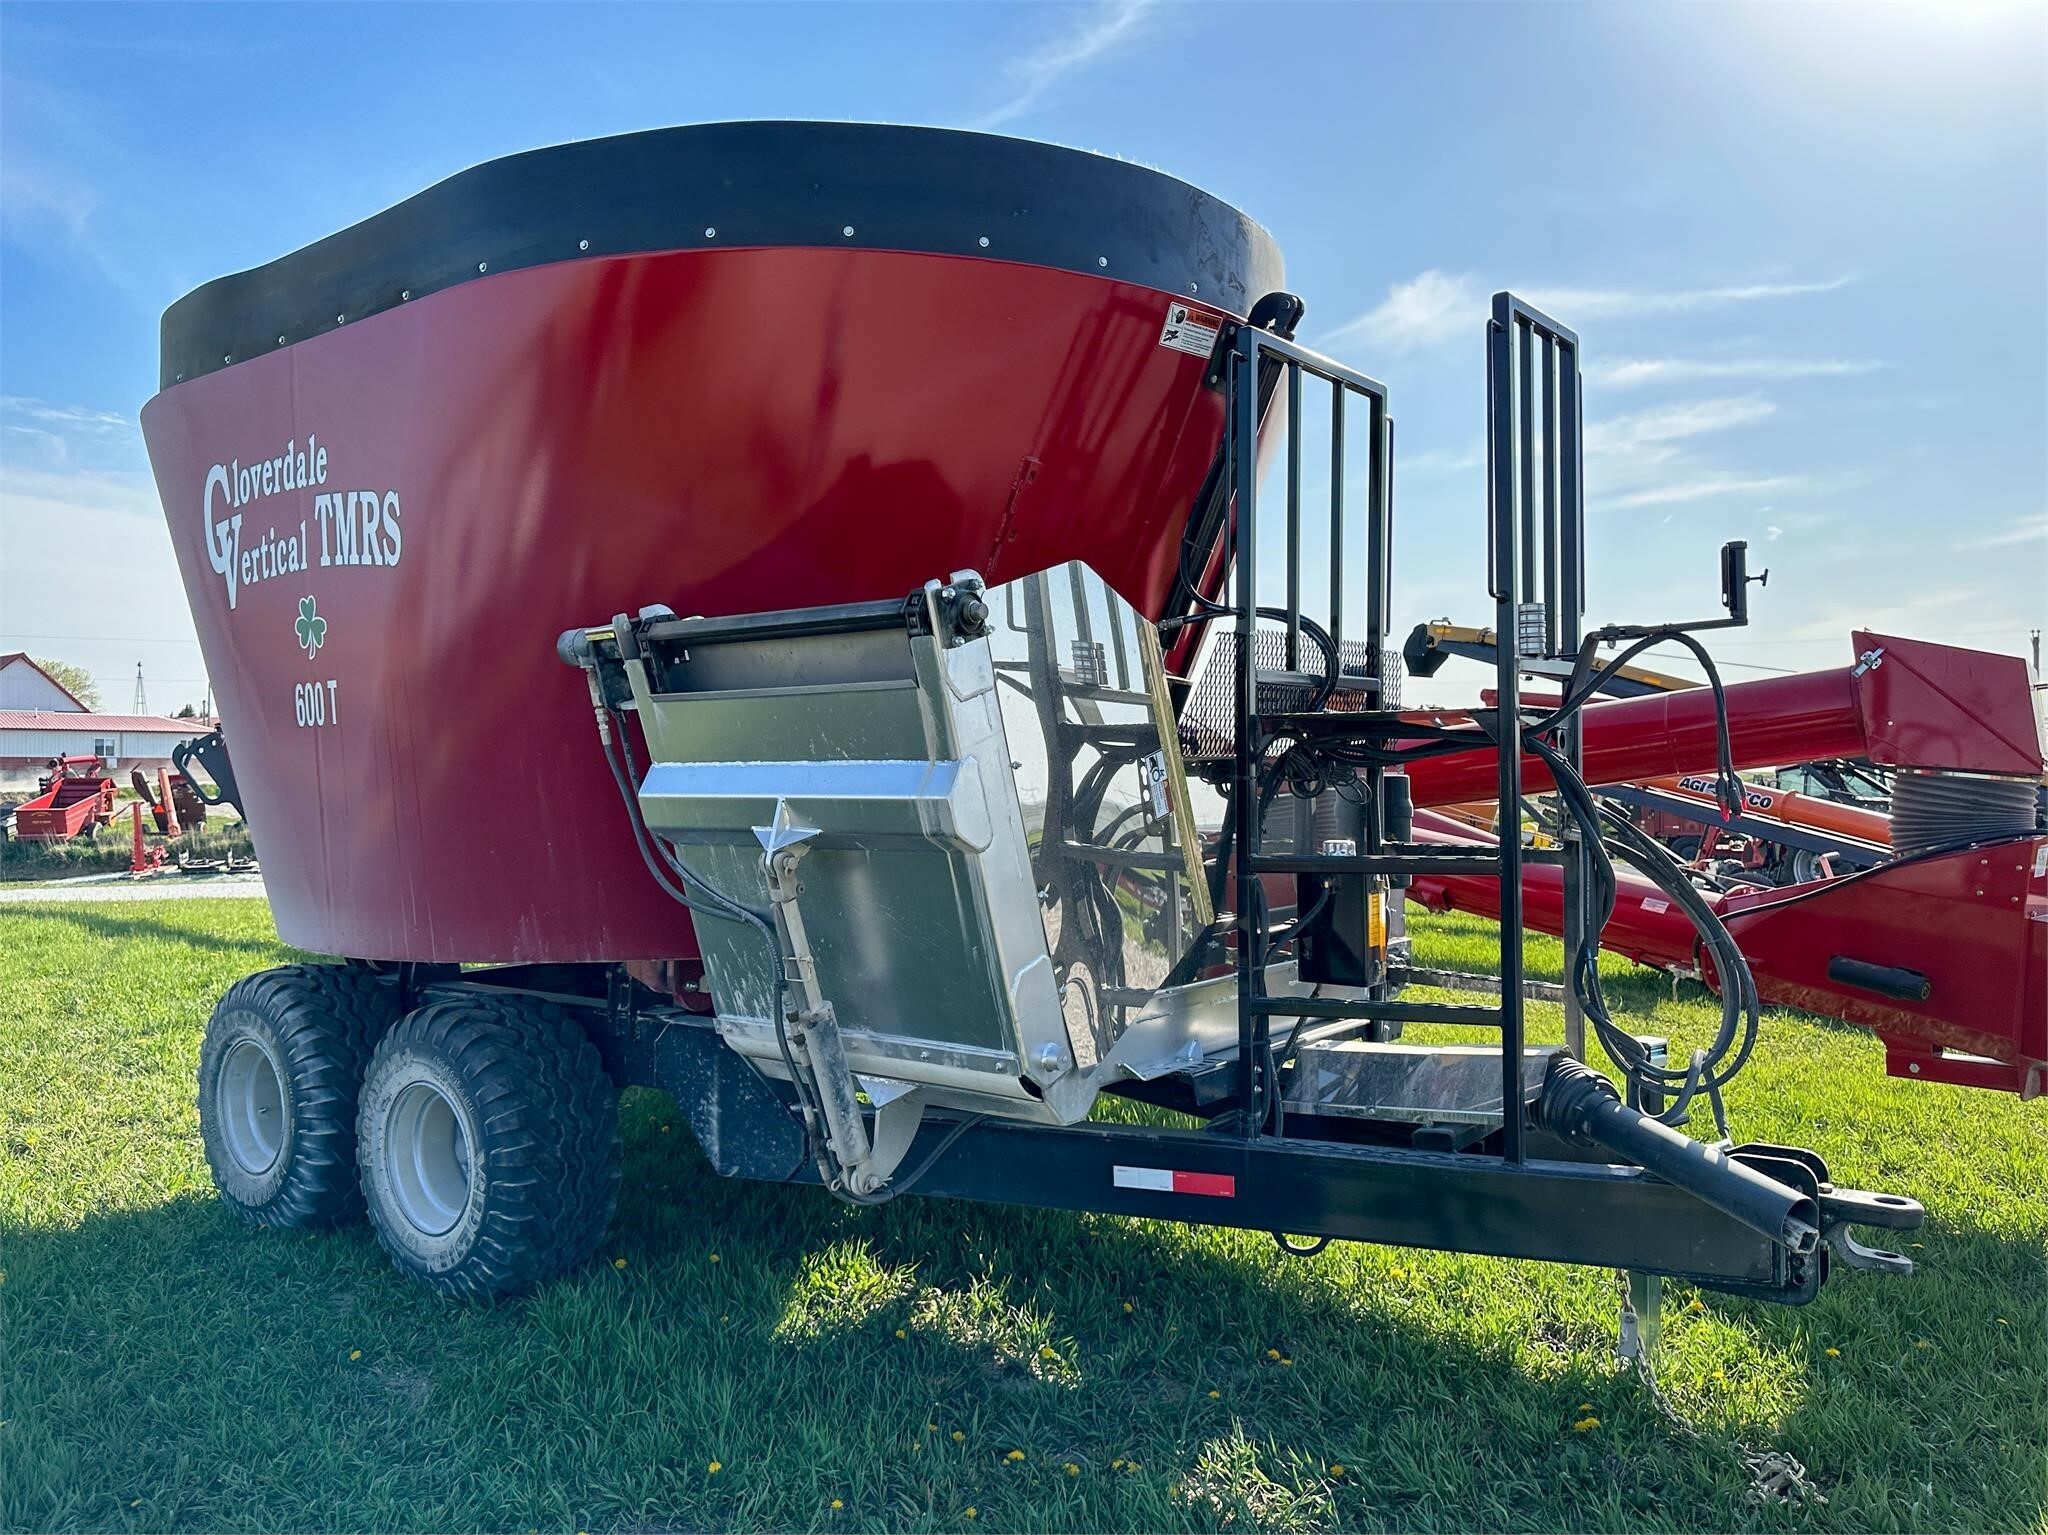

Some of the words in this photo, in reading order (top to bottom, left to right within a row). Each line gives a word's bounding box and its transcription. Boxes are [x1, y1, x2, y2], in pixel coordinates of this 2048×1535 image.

[203, 433, 328, 575] Cloverdale
[215, 512, 309, 611] Vertical
[314, 489, 402, 568] TMRS
[295, 681, 325, 728] 600
[326, 679, 338, 726] T
[1678, 776, 1707, 793] AGI
